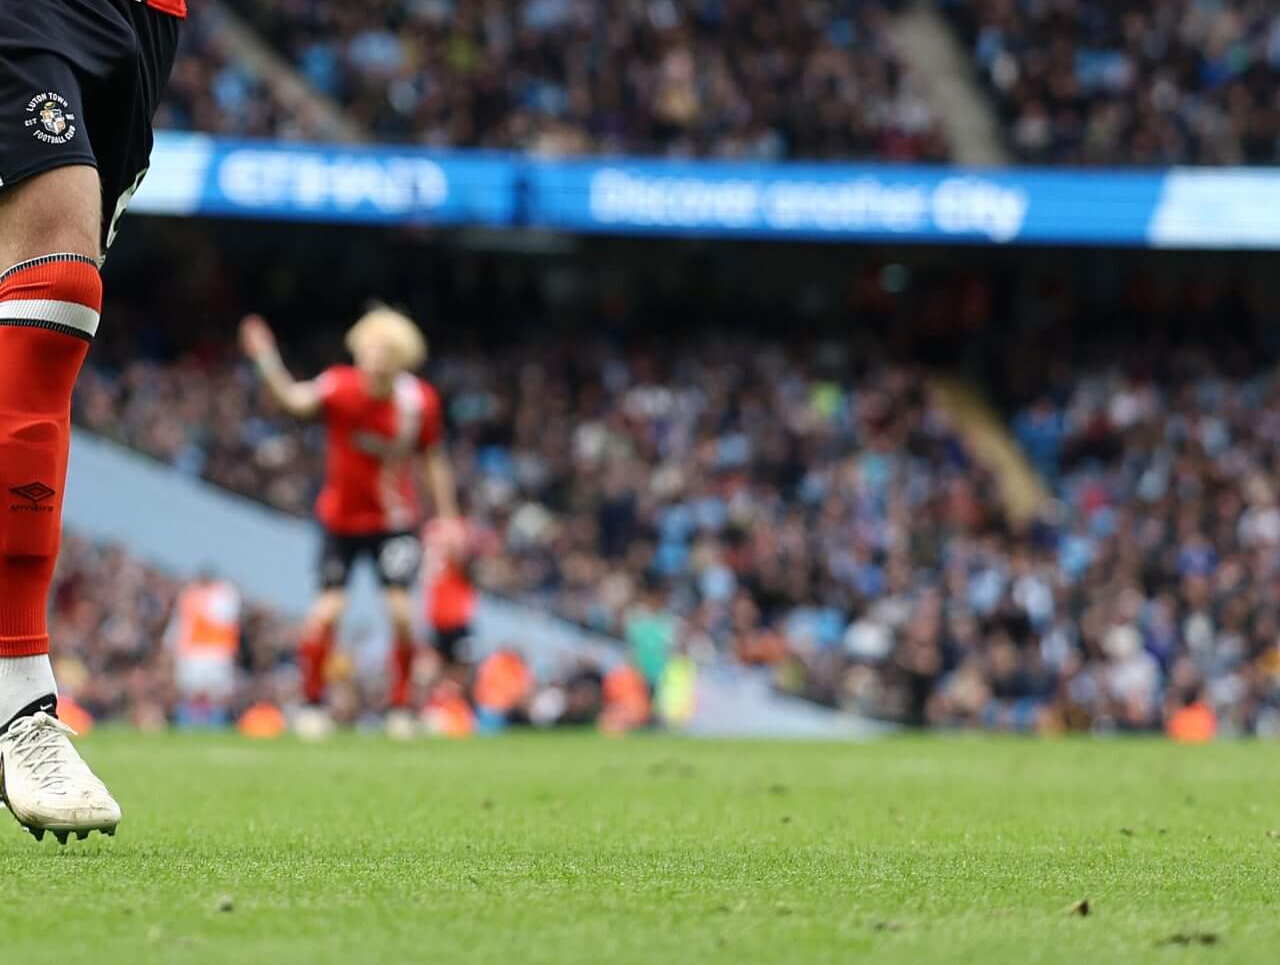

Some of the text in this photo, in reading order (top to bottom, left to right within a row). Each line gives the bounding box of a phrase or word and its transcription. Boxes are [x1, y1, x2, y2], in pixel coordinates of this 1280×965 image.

[25, 92, 69, 112] LUTON TOWN
[32, 129, 67, 144] FOOTBALL
